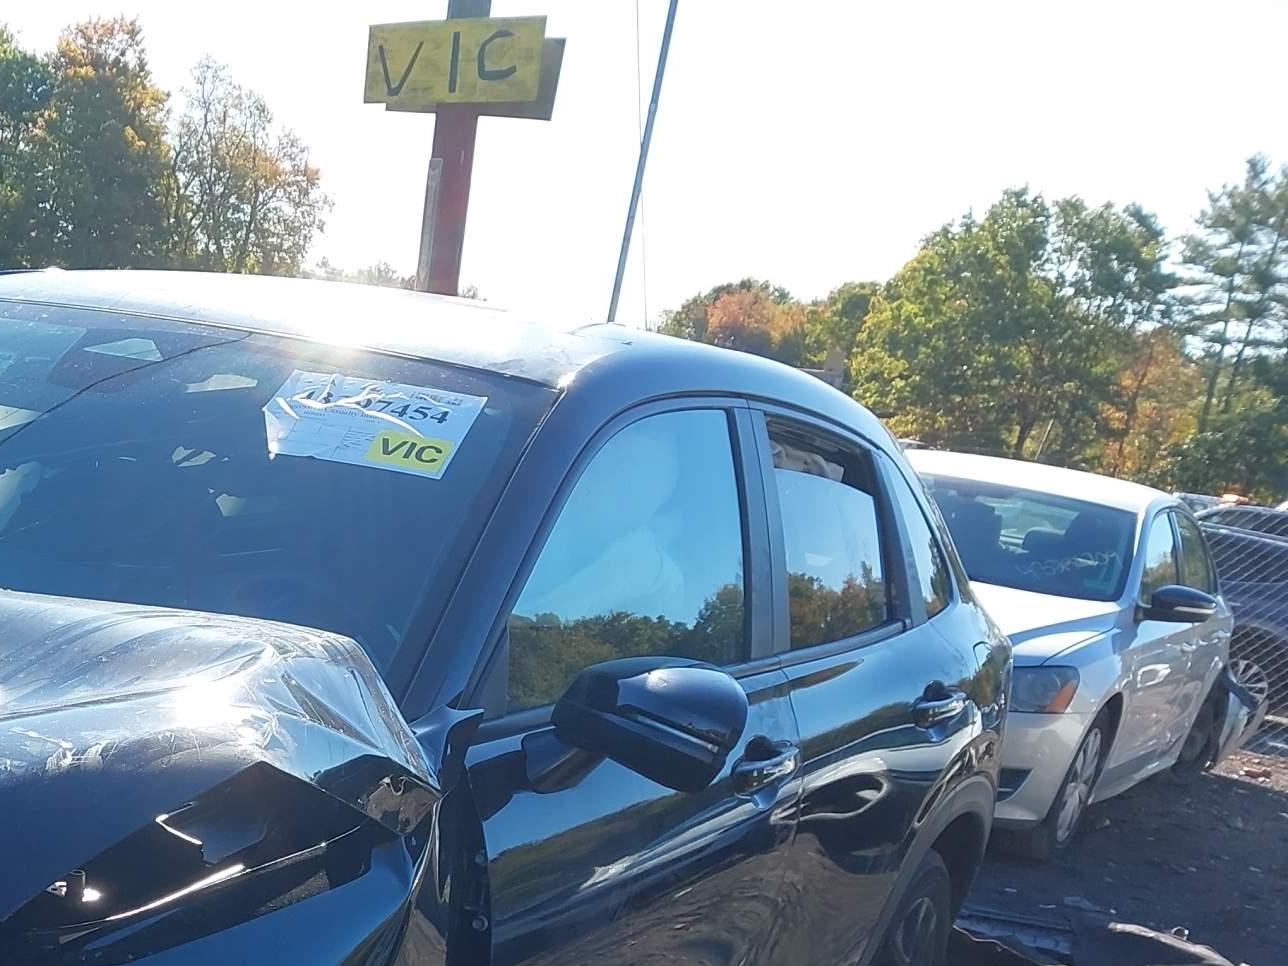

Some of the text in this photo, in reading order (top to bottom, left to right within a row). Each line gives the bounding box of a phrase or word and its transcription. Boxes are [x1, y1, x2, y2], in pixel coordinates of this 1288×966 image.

[378, 30, 517, 97] VIC
[295, 388, 451, 424] 437454
[381, 437, 443, 464] VIC
